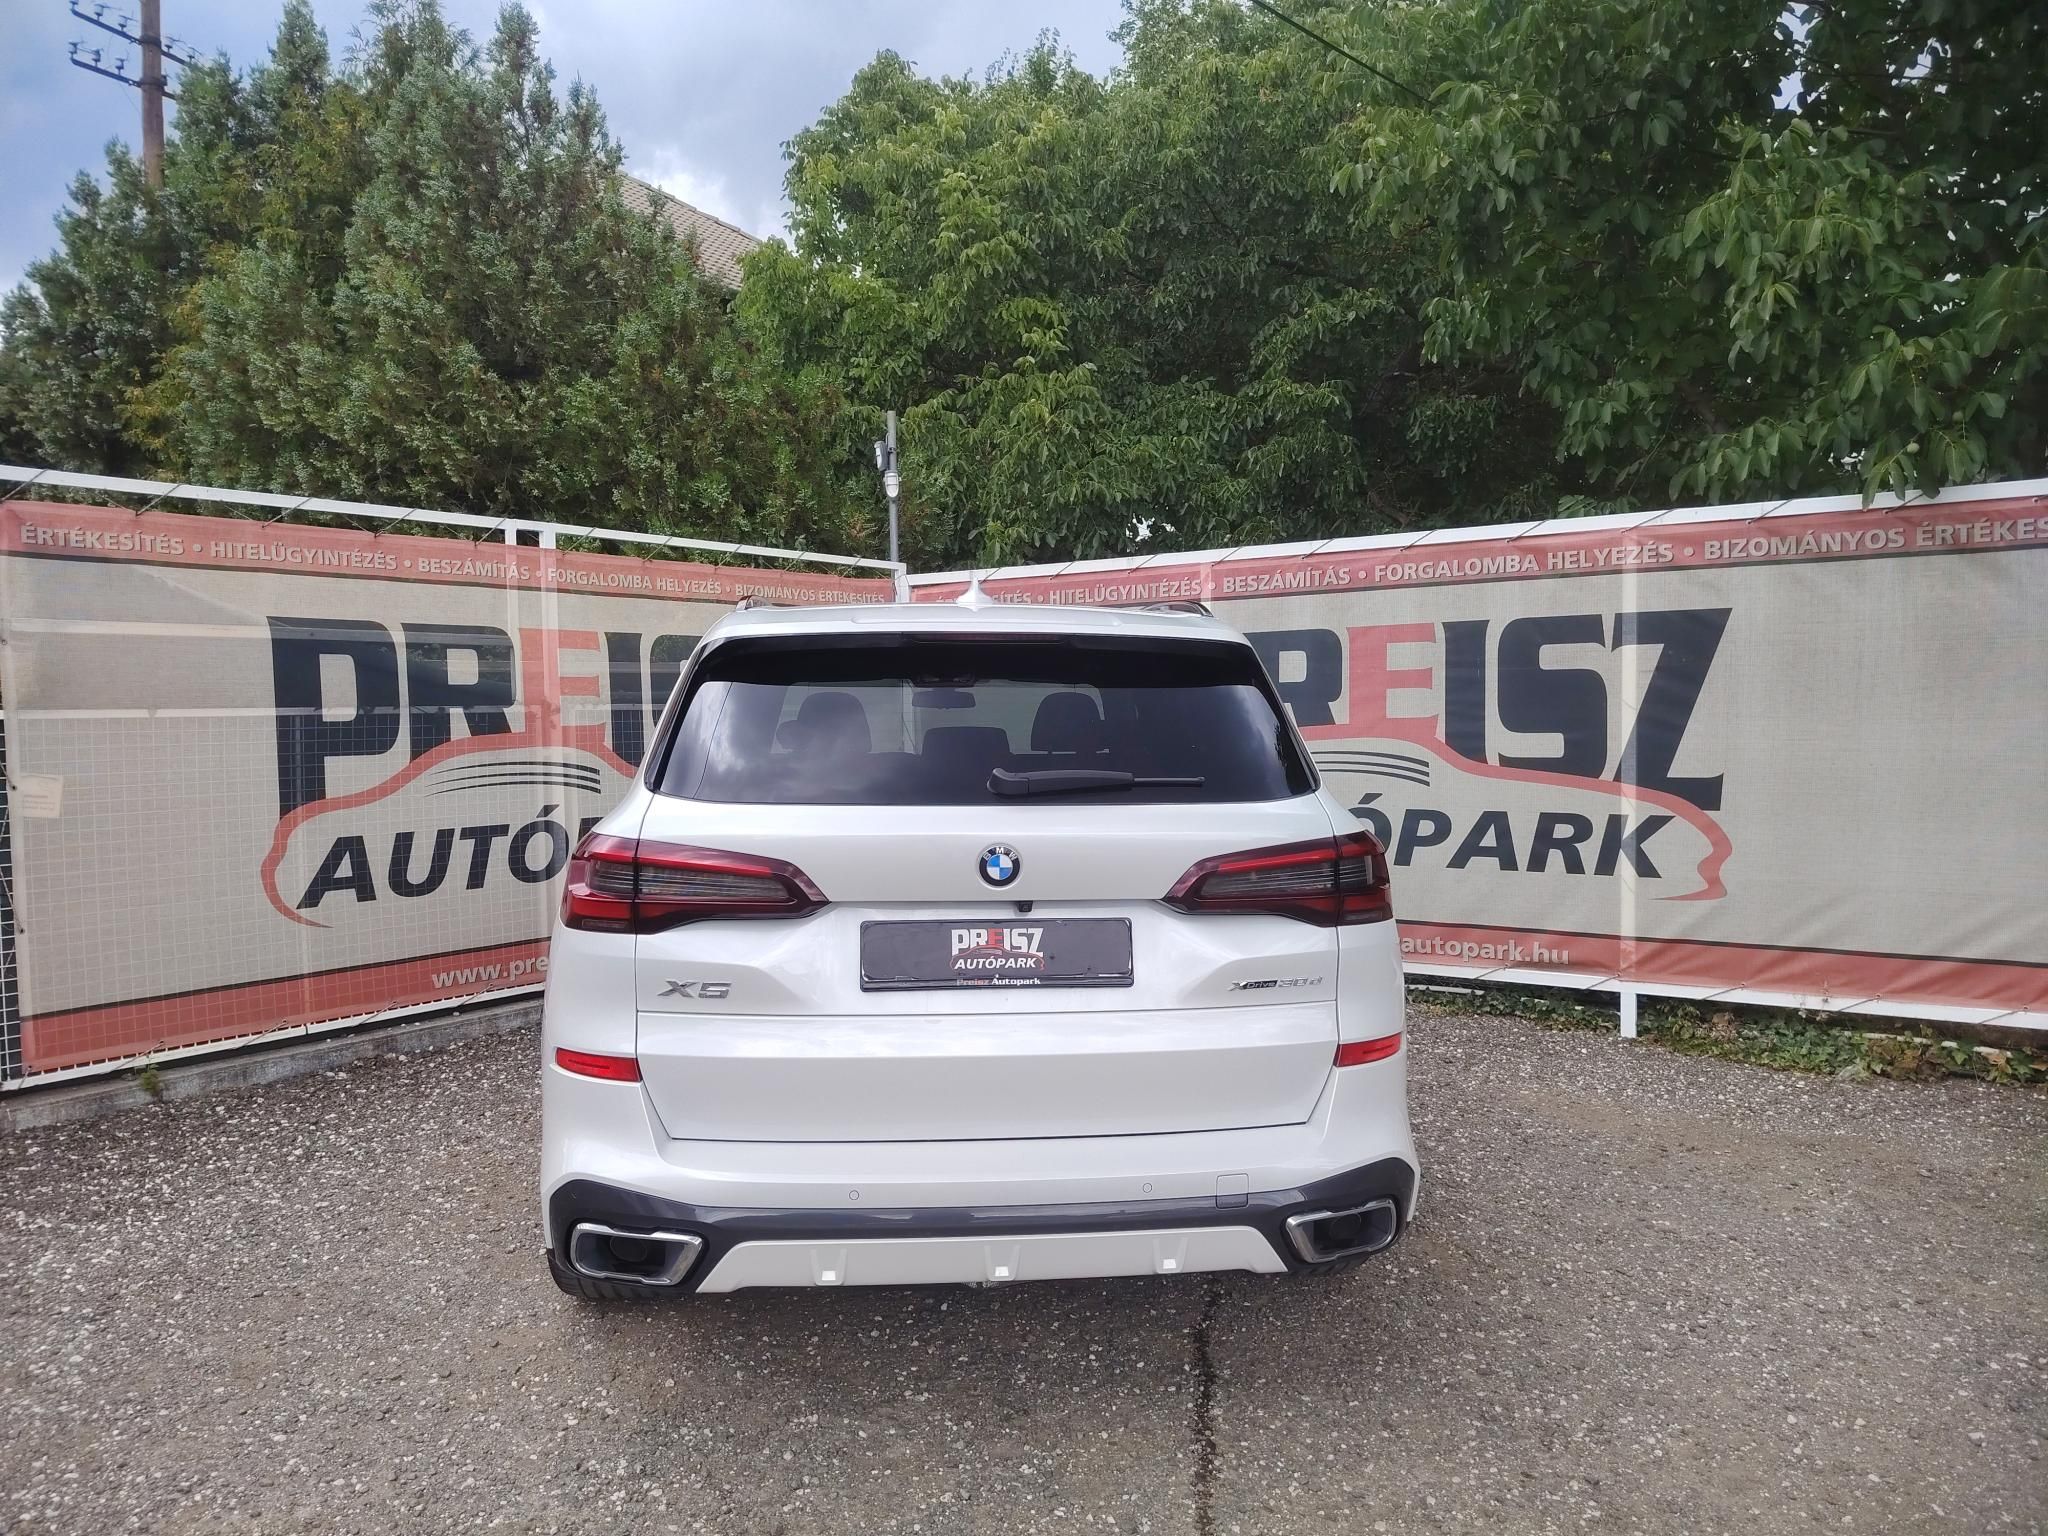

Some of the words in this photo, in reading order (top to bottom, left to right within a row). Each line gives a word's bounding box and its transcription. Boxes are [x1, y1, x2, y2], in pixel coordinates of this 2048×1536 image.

[20, 522, 184, 556] ÉRTÉKESÍTÉS
[210, 541, 398, 571] HITELÜGYINTÉZÉS
[418, 557, 531, 580] BESZÁMÍTÁS
[547, 568, 653, 591] FORGALOMBA
[656, 574, 722, 595] HELYEZÉS
[735, 584, 816, 601] BIZOMÁNYOS
[1049, 575, 1202, 606] HITELÜGYINTÉZÉS
[1223, 565, 1351, 593] BESZÁMÍTÁS
[1374, 553, 1540, 583] FORGALOMBA
[1547, 540, 1675, 570] HELYEZÉS
[1703, 528, 1905, 561] BIZOMÁNYOS
[1915, 517, 2048, 547] ÉRTÉKES
[296, 804, 604, 909] AUTÓ
[983, 846, 1018, 861] BMW
[951, 928, 1044, 958] PREISZ
[1399, 936, 1570, 966] autopark.hu
[953, 955, 1038, 970] AUTÓPARK
[656, 978, 733, 999] X5
